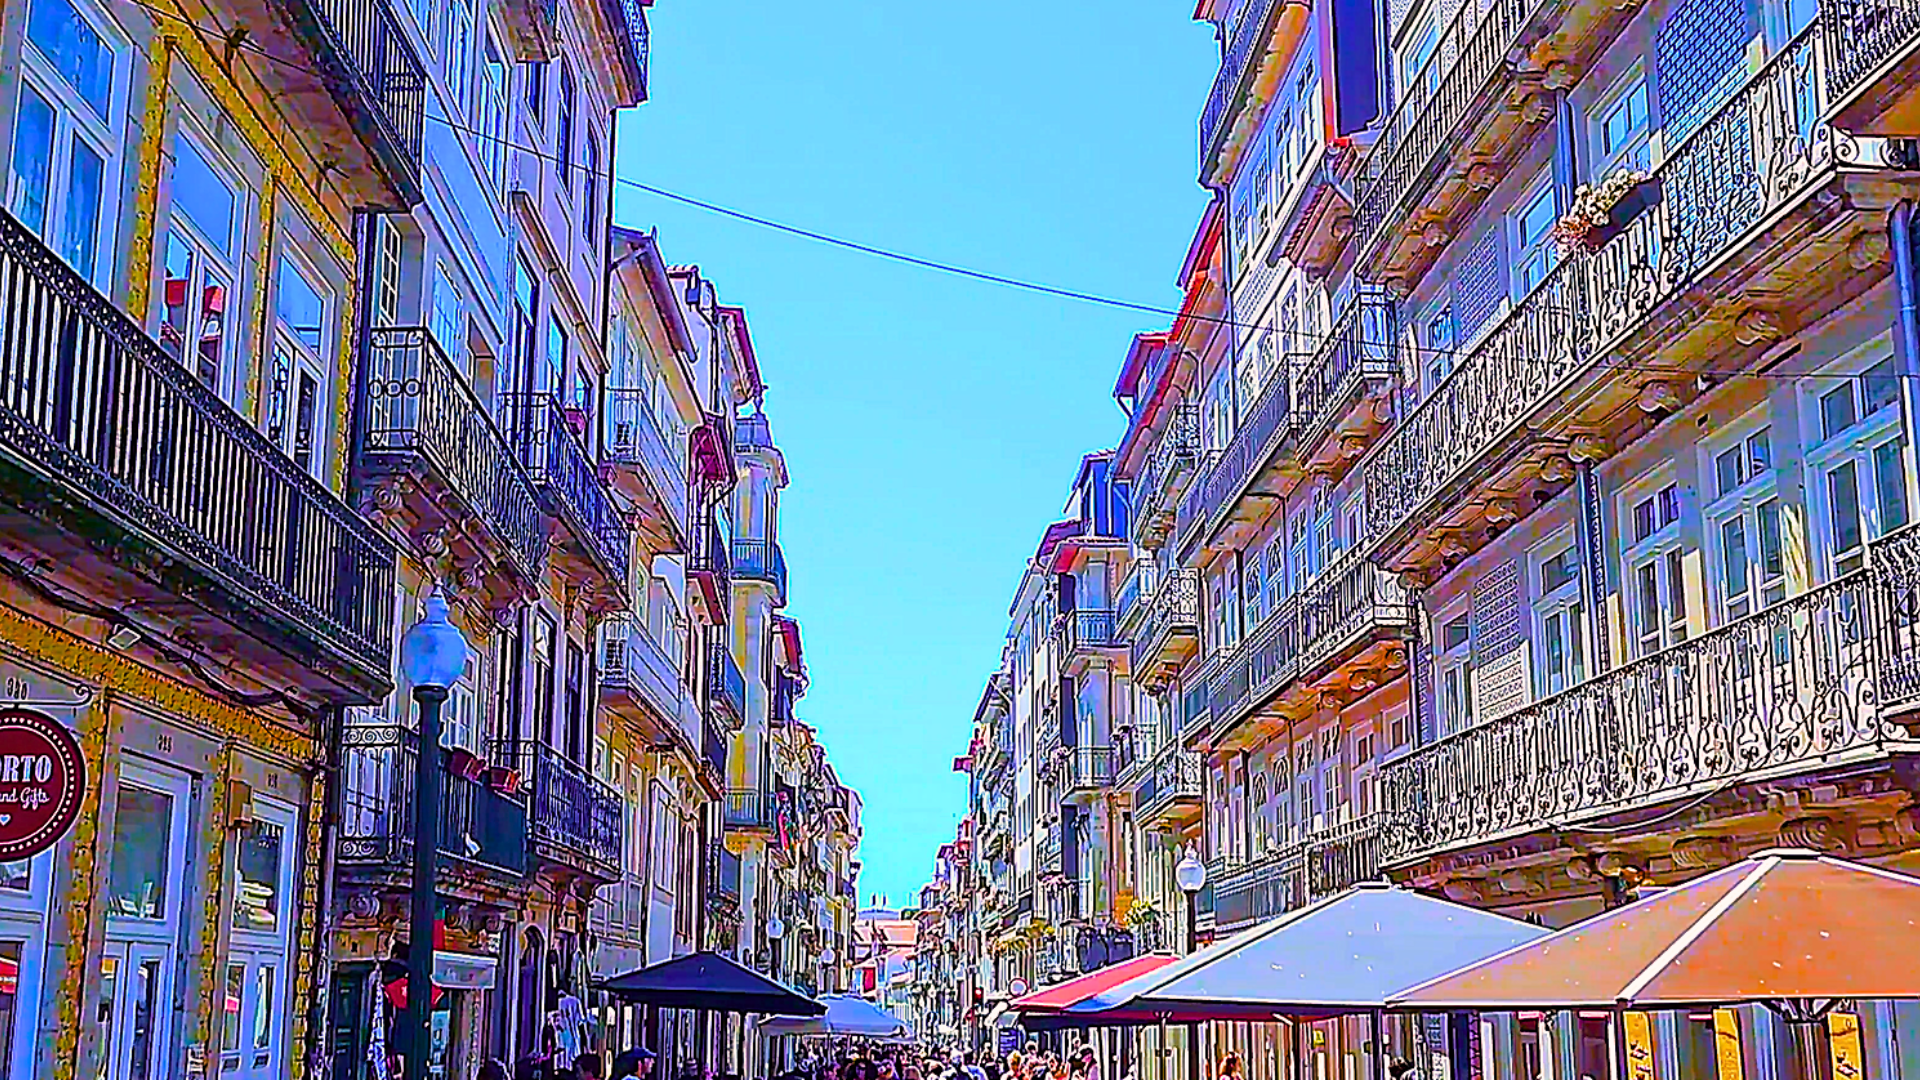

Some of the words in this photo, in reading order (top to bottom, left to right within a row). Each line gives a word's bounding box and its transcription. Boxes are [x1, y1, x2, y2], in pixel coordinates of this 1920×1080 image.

[0, 754, 52, 783] RTO
[0, 787, 18, 803] nd
[20, 786, 50, 811] Gifts
